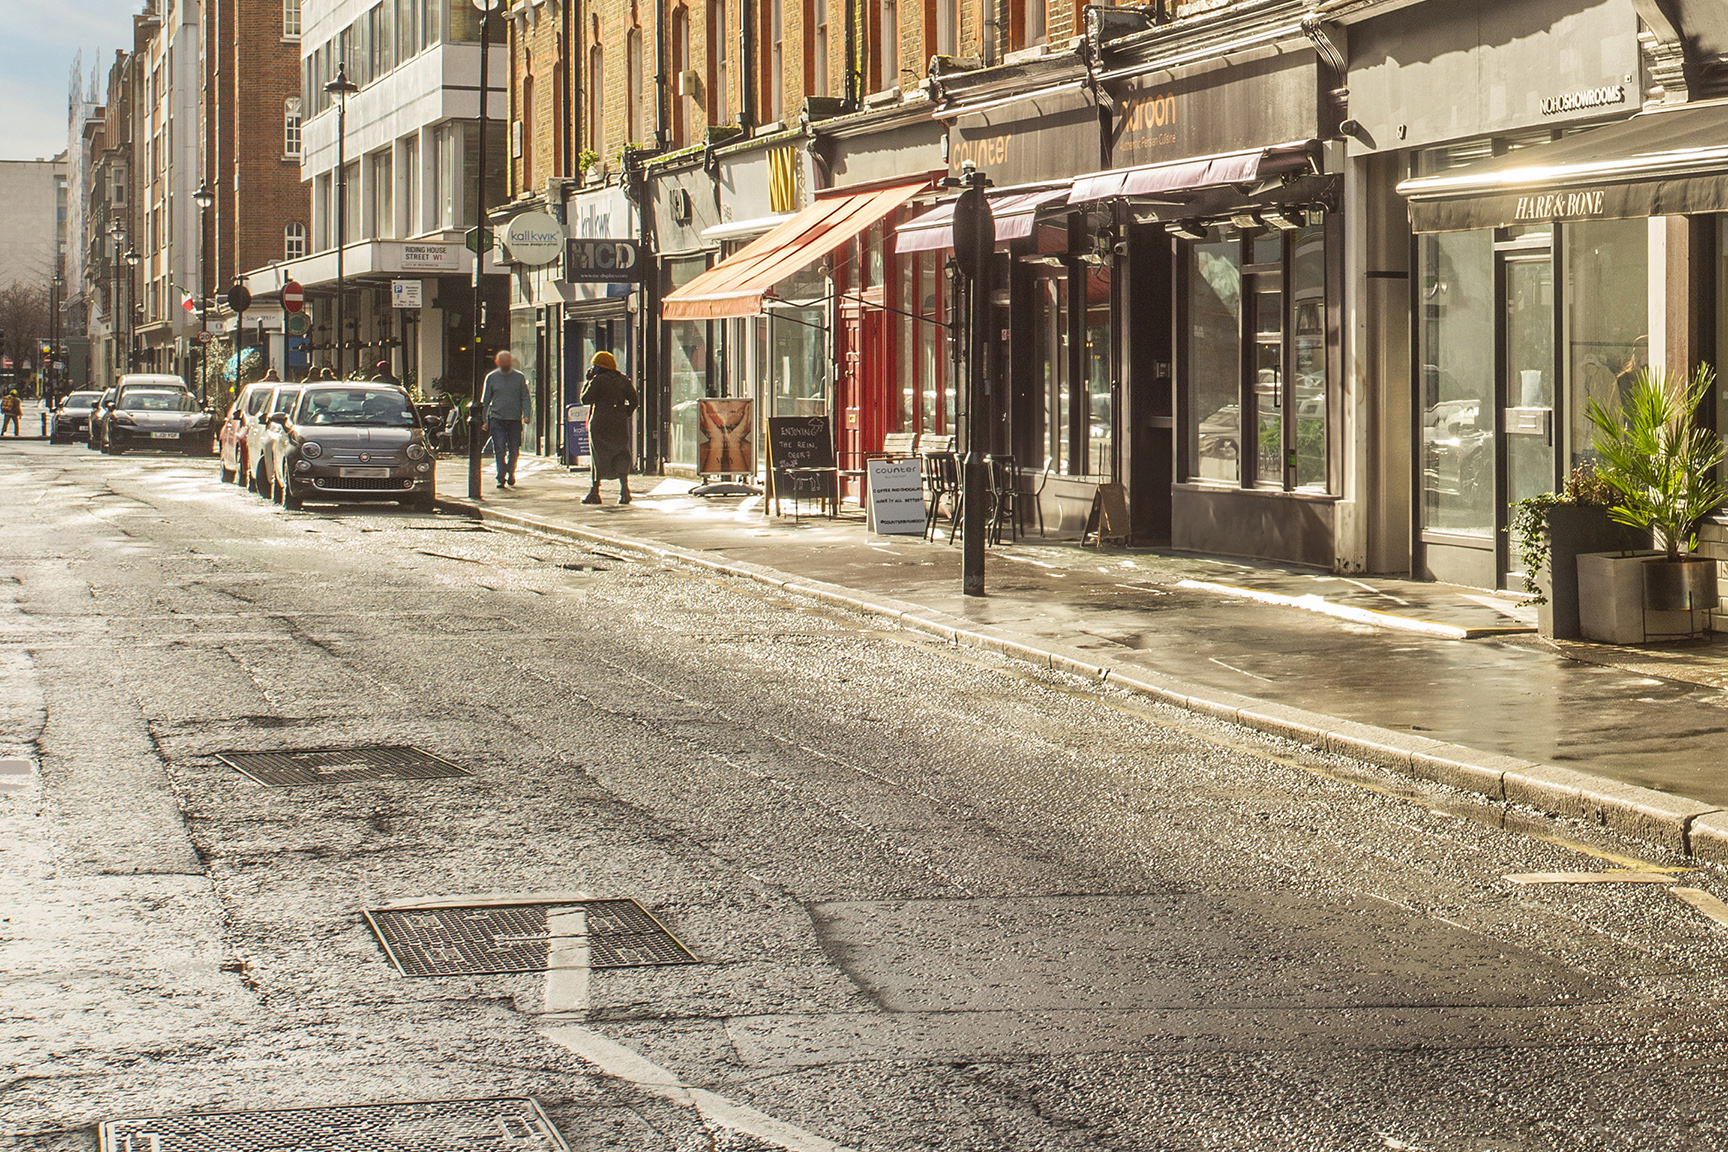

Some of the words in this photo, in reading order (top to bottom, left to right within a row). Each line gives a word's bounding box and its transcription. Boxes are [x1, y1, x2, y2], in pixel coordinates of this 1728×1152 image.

[952, 133, 1012, 171] counter
[426, 246, 447, 254] HOUSE
[571, 242, 636, 269] MCD
[780, 427, 817, 437] ENJOYING
[875, 466, 917, 474] counter
